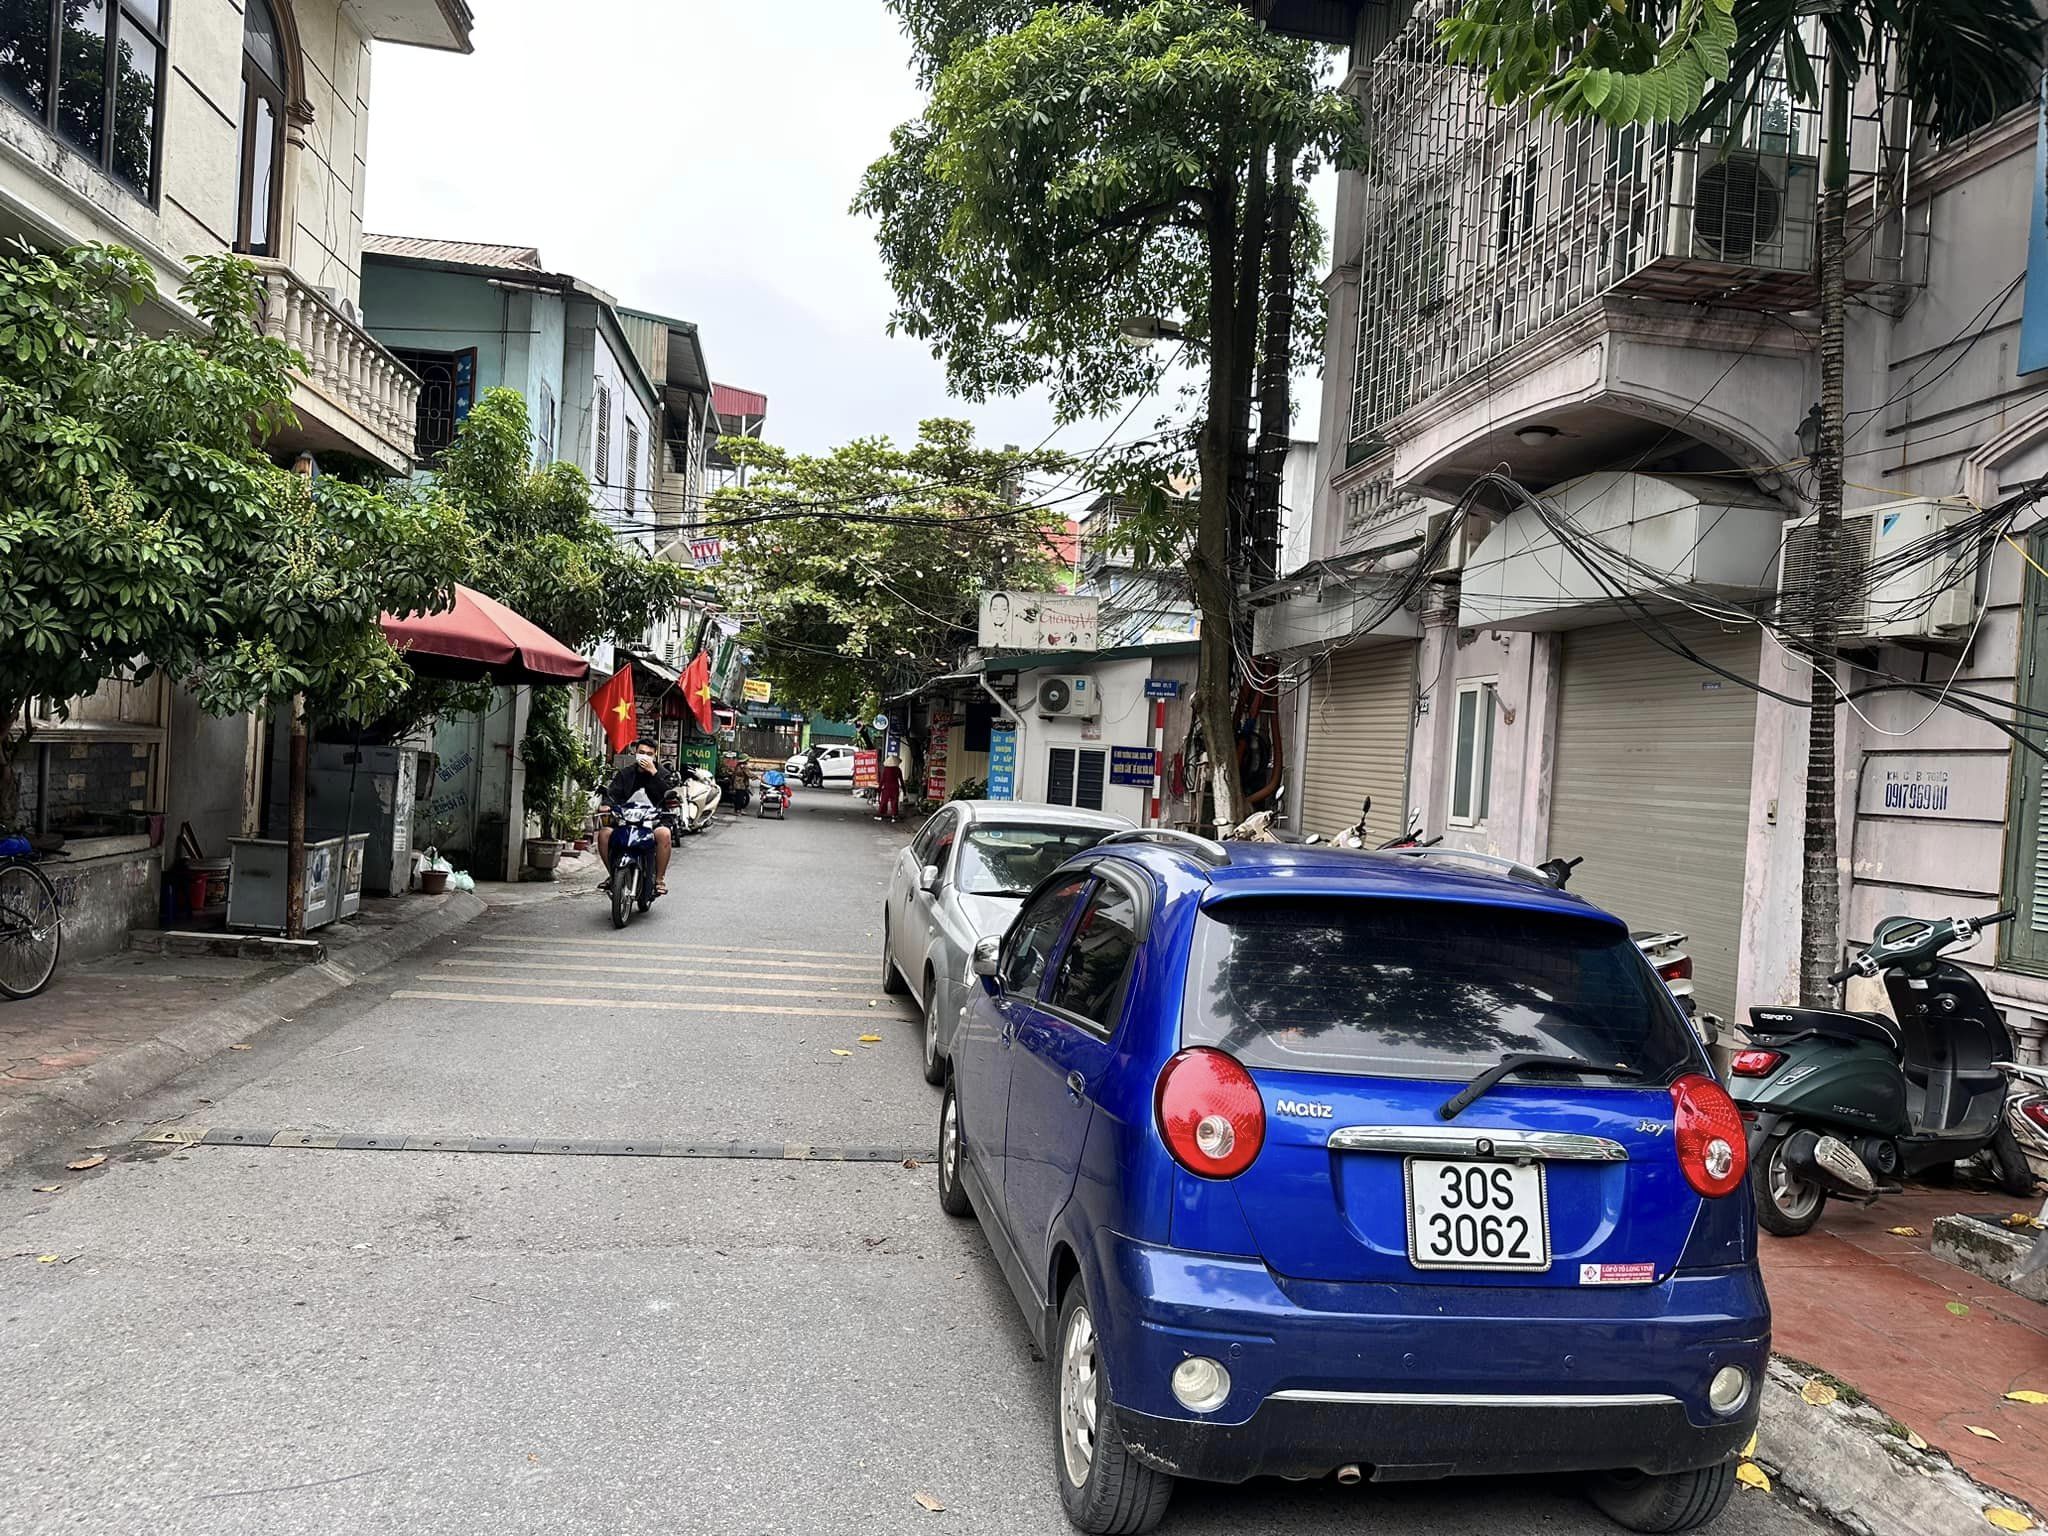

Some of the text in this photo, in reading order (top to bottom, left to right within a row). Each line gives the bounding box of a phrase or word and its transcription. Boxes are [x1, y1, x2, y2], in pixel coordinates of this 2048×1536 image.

[1885, 783, 1948, 810] 0917969011
[1276, 1099, 1334, 1118] Matiz
[1439, 1165, 1514, 1210] 30S
[1428, 1212, 1531, 1258] 3062
